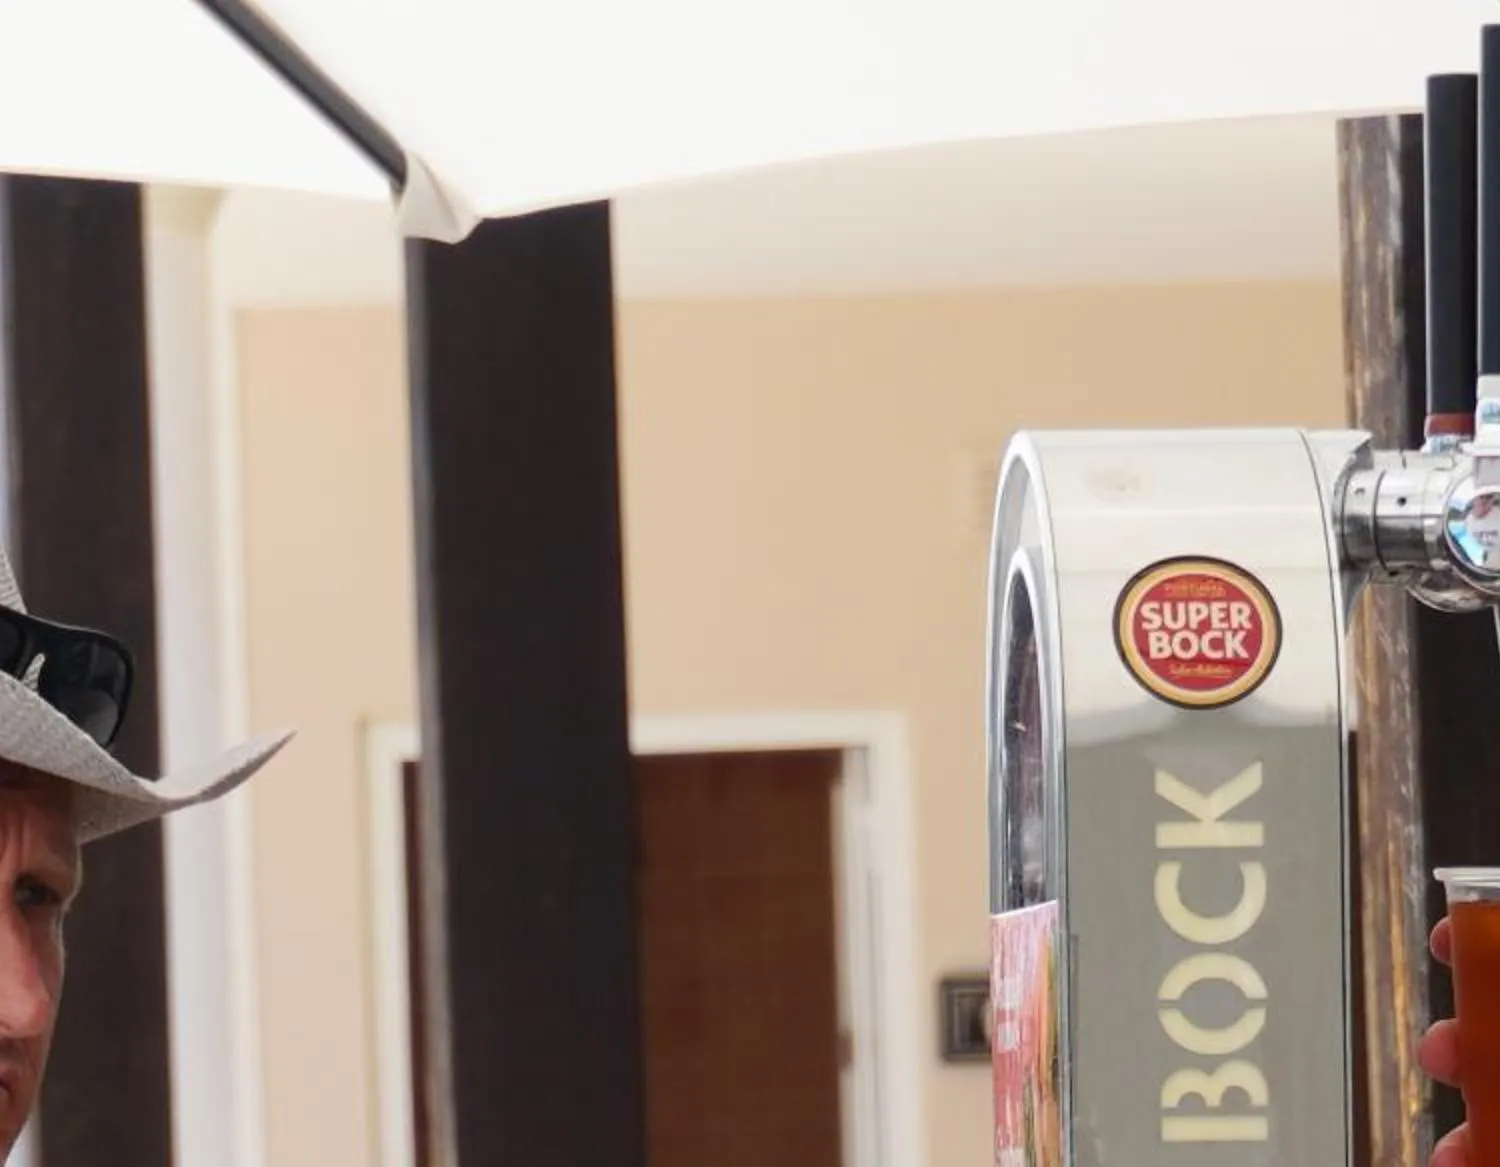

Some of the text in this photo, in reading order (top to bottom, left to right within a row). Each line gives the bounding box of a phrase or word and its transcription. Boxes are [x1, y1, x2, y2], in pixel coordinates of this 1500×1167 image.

[1140, 600, 1252, 630] SUPER
[1149, 630, 1249, 659] BOCK
[1153, 761, 1269, 1142] BOCK
